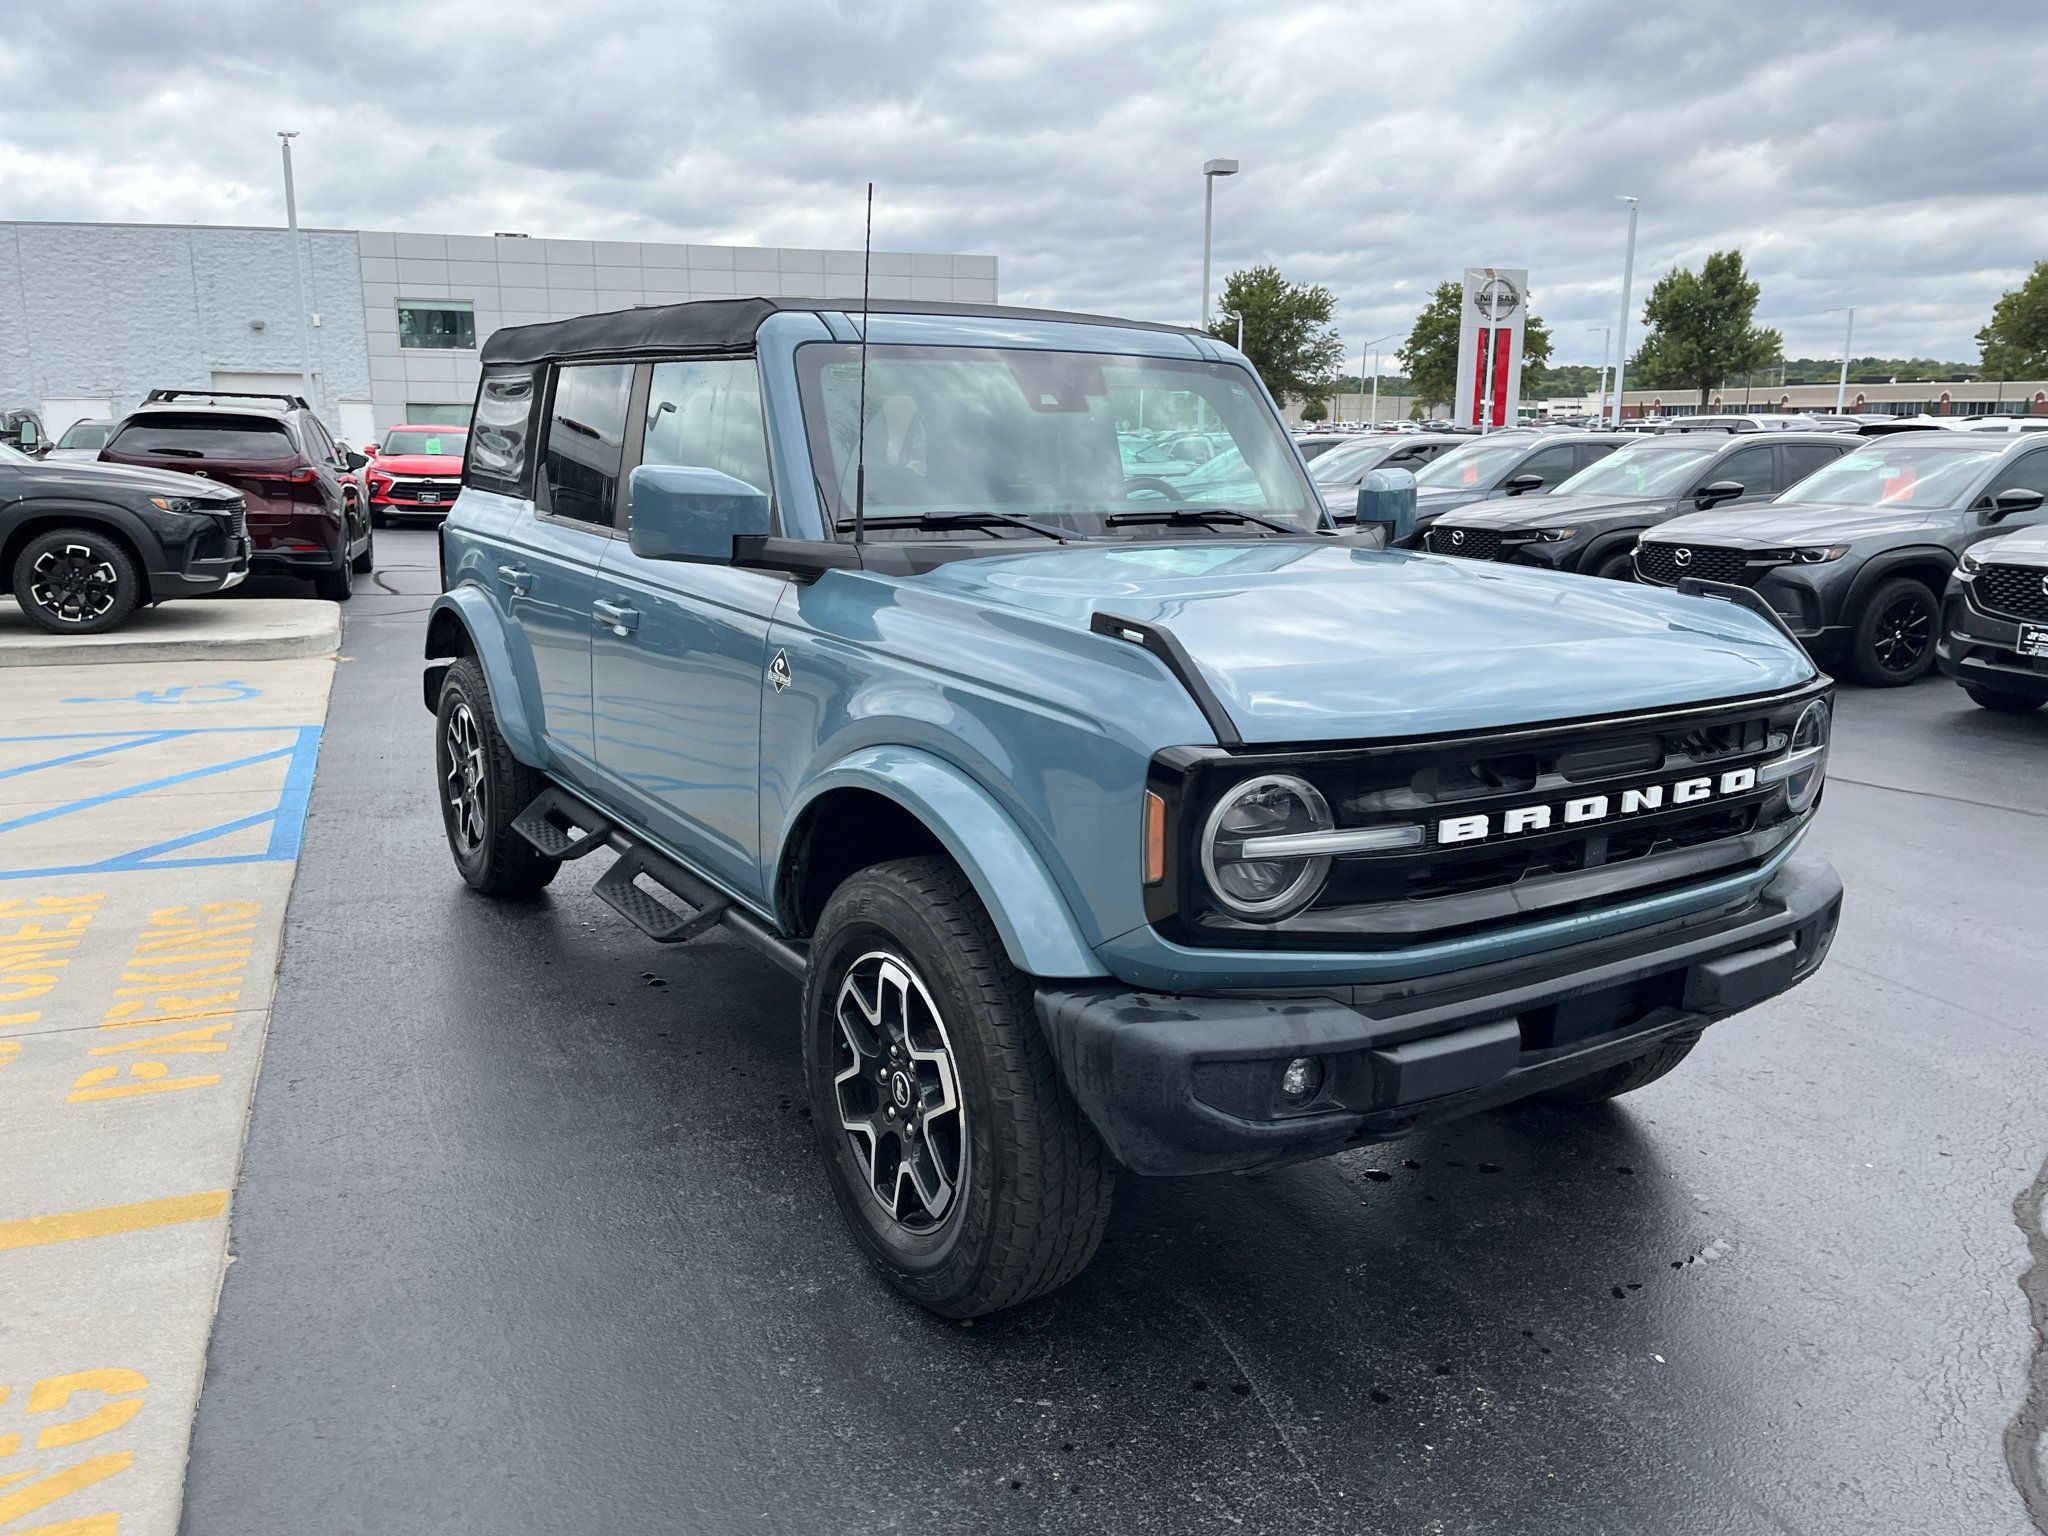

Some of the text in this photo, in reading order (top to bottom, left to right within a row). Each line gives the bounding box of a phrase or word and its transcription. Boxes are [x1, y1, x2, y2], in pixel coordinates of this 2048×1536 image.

[1480, 294, 1518, 303] NISAN
[1438, 767, 1756, 844] BRONCO
[65, 901, 261, 1103] PARKING
